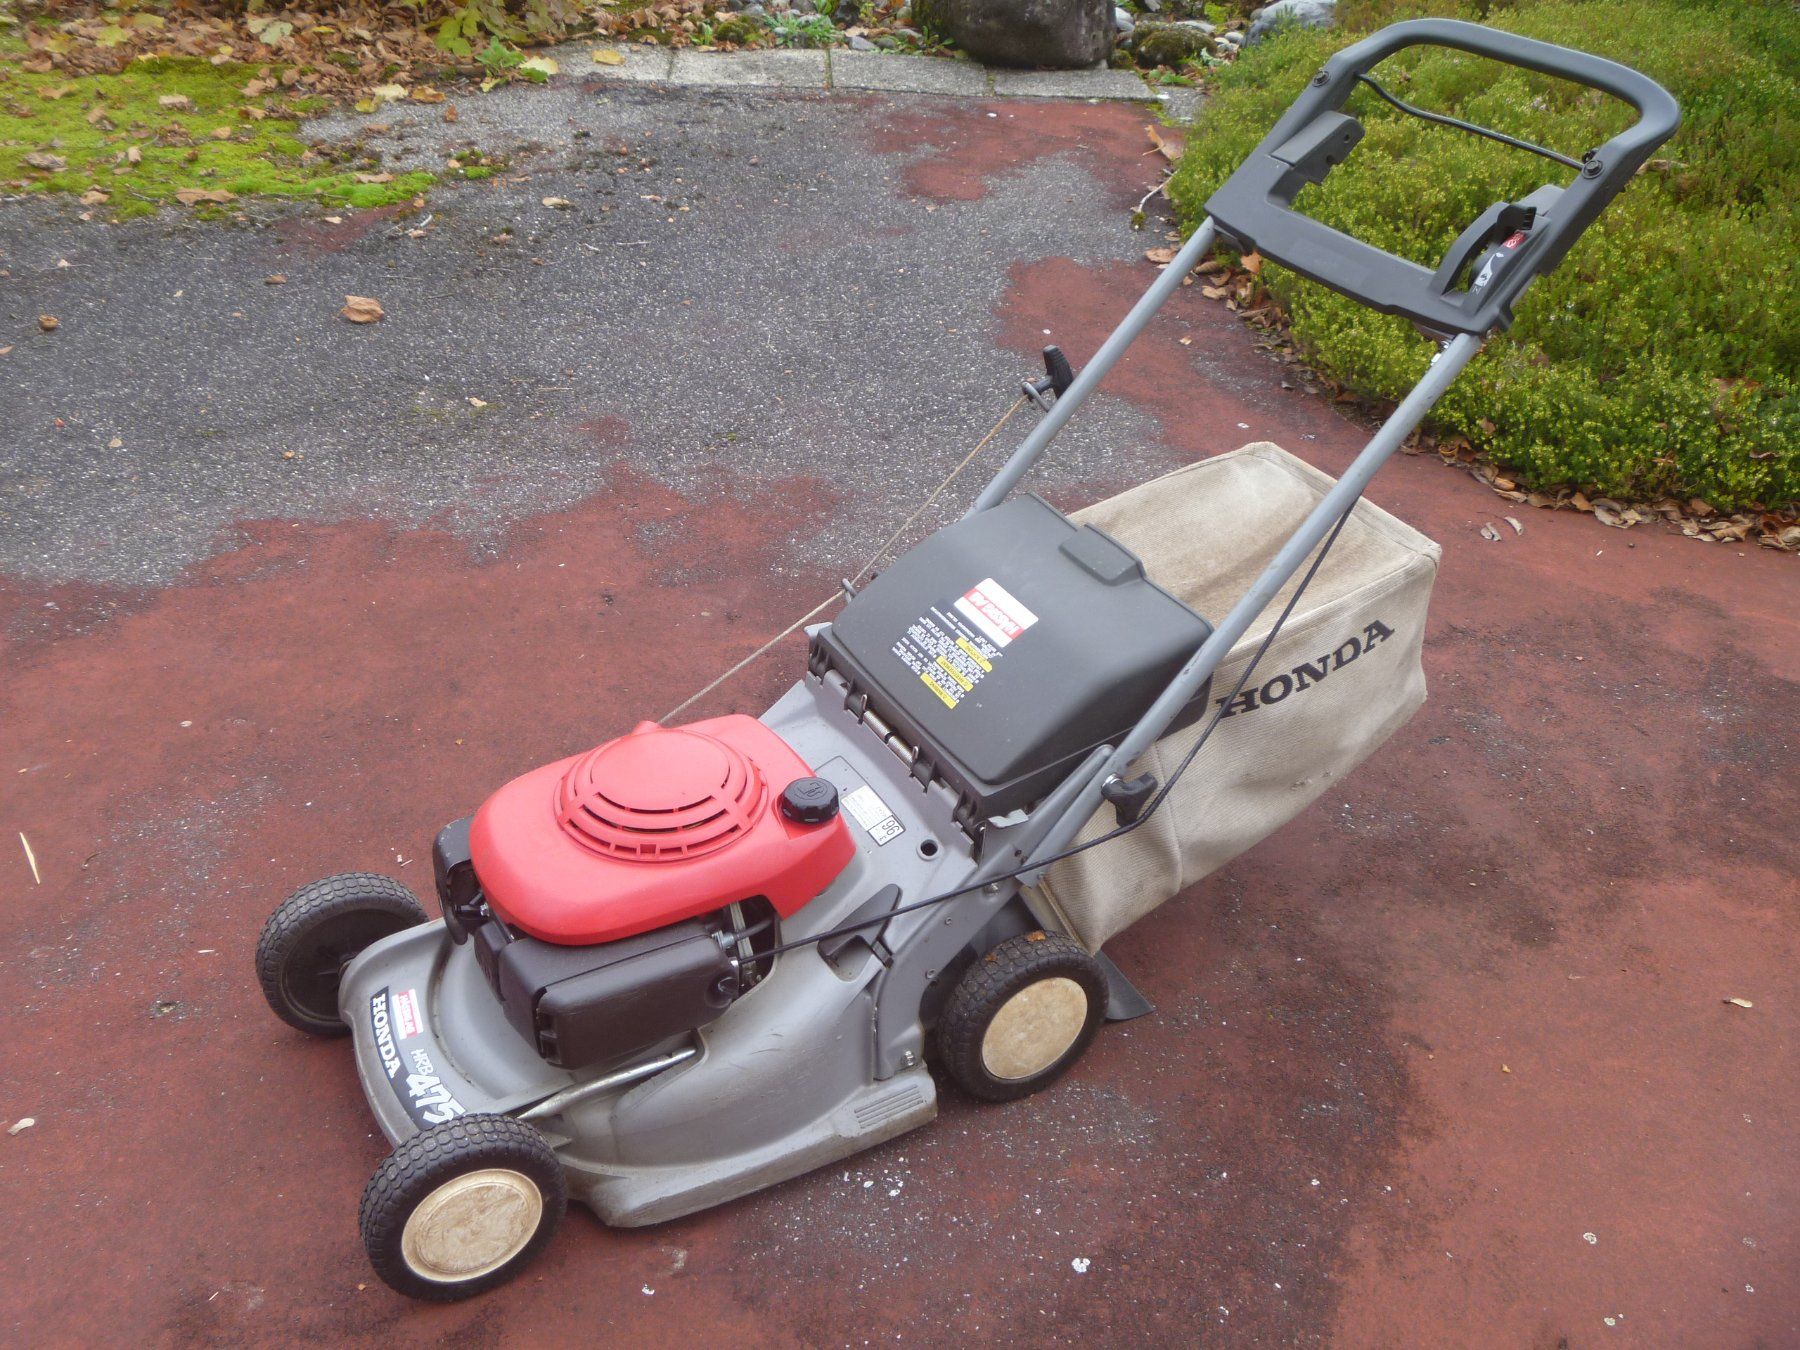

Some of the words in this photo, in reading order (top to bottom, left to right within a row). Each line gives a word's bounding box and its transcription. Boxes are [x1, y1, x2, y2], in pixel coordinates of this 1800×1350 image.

[1215, 619, 1395, 719] HONDA
[882, 820, 900, 836] 96
[372, 993, 401, 1079] HONDA
[410, 1049, 434, 1076] HRB
[406, 1073, 467, 1124] 475
